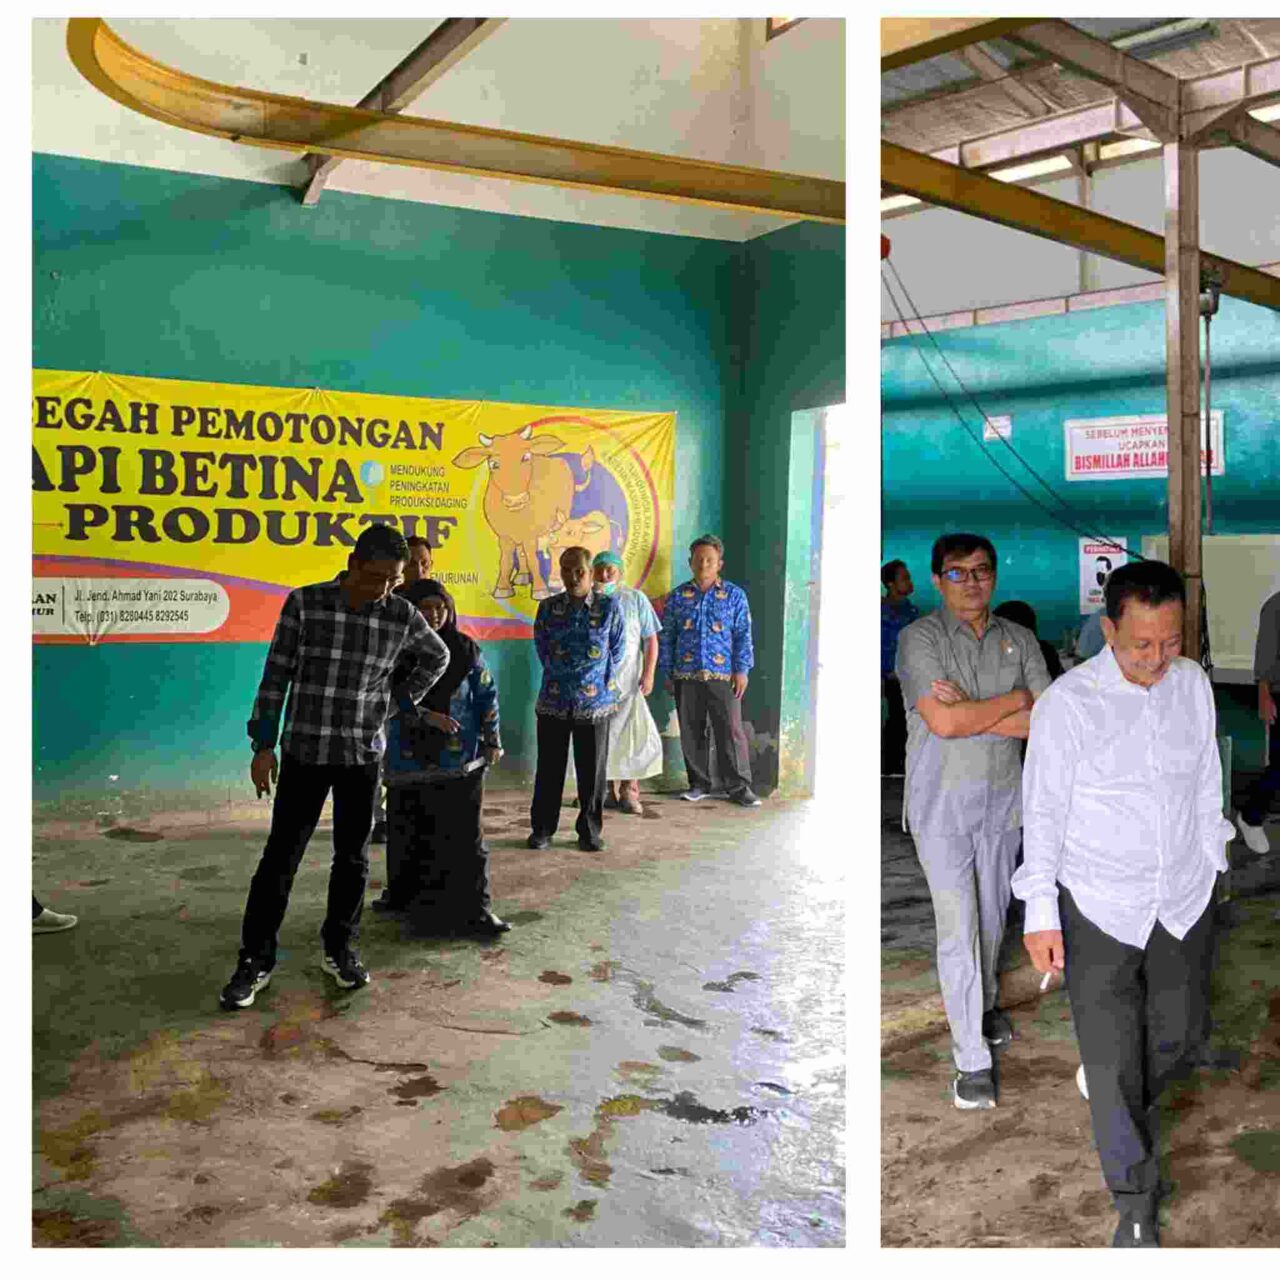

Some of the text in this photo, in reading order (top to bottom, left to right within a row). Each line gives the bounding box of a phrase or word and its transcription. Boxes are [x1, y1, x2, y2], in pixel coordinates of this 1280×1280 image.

[32, 396, 445, 451] EGAH PEMOTONGAN
[1119, 439, 1166, 451] UCAPKAN
[1074, 454, 1130, 470] BISMILLAH
[138, 448, 364, 503] BETINA
[390, 464, 445, 477] MENDUKUNG
[390, 480, 450, 493] PENINGKATAN
[390, 495, 468, 510] PRODUKSI DAGING
[112, 590, 141, 601] Ahmad
[143, 590, 161, 601] Yani
[163, 590, 177, 601] 202
[180, 590, 217, 604] Surabaya
